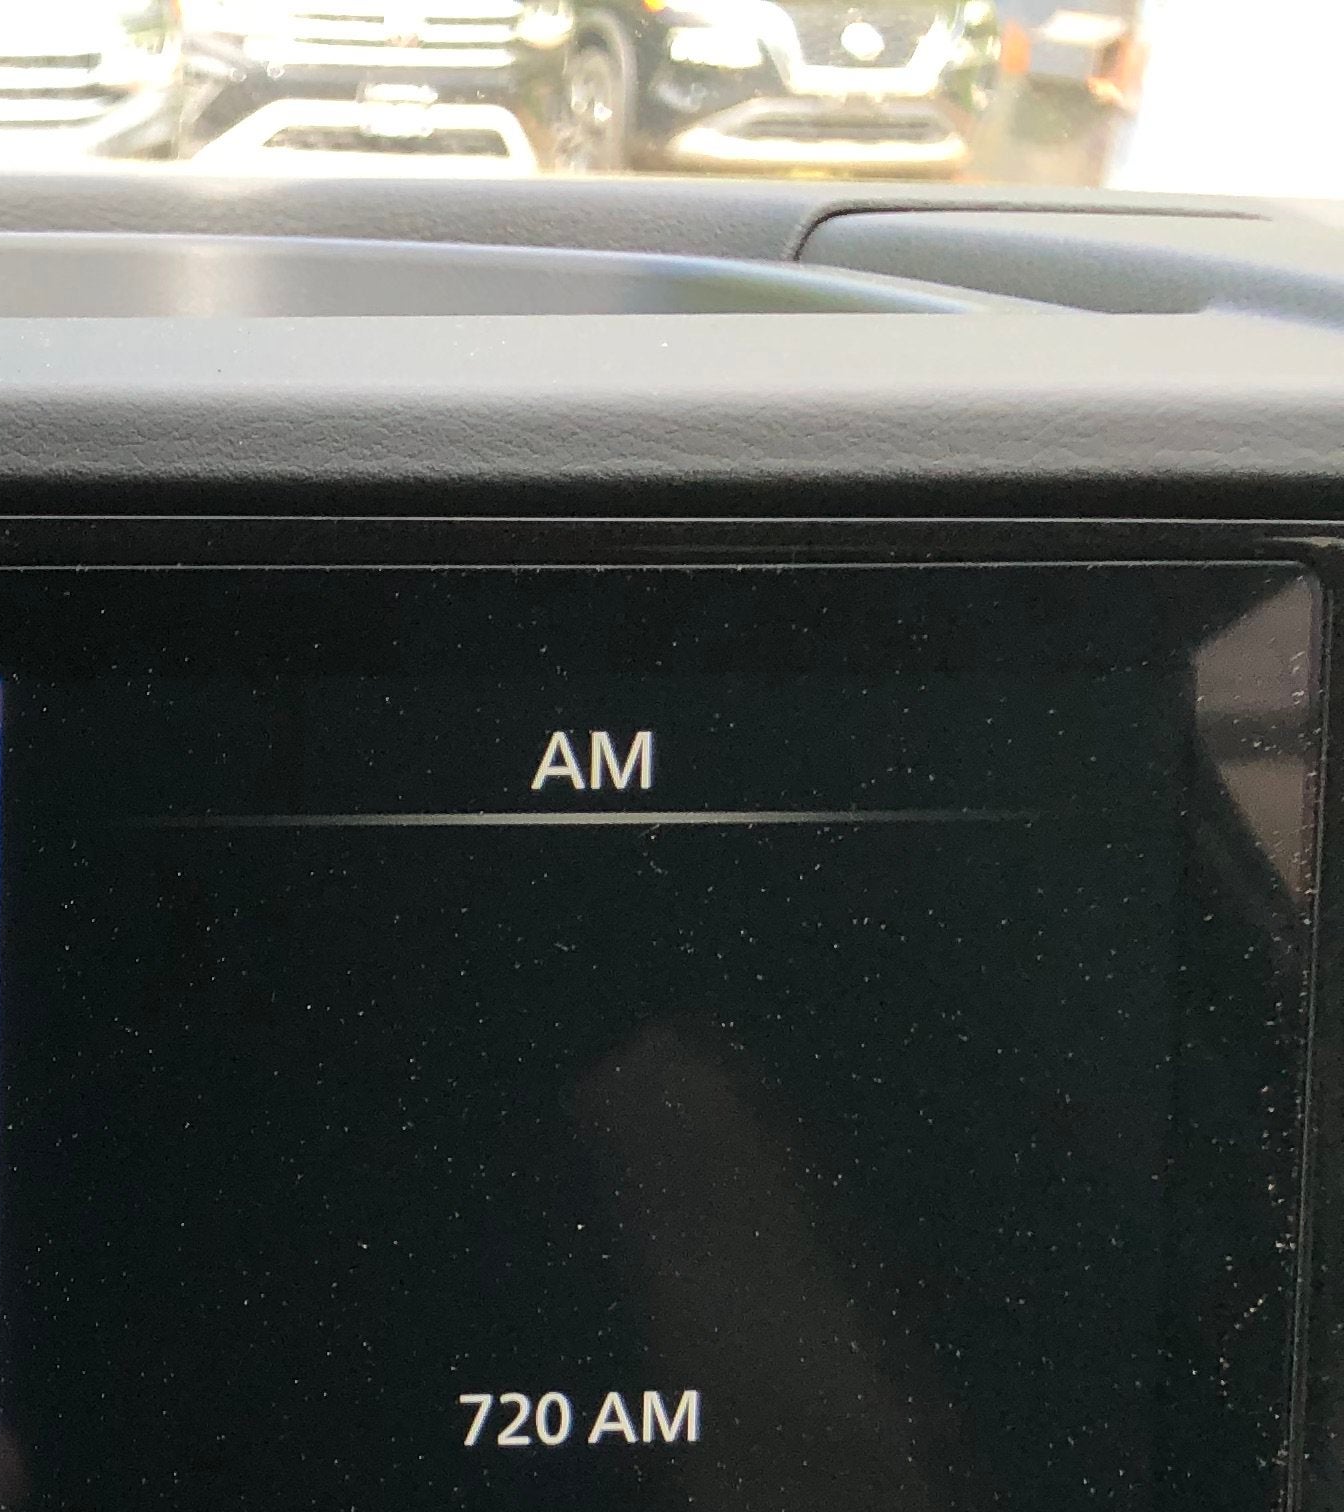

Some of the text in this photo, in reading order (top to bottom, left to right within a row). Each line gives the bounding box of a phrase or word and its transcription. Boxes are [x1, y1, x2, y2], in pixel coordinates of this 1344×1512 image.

[530, 730, 656, 790] AM
[460, 1390, 701, 1447] 720 AM
